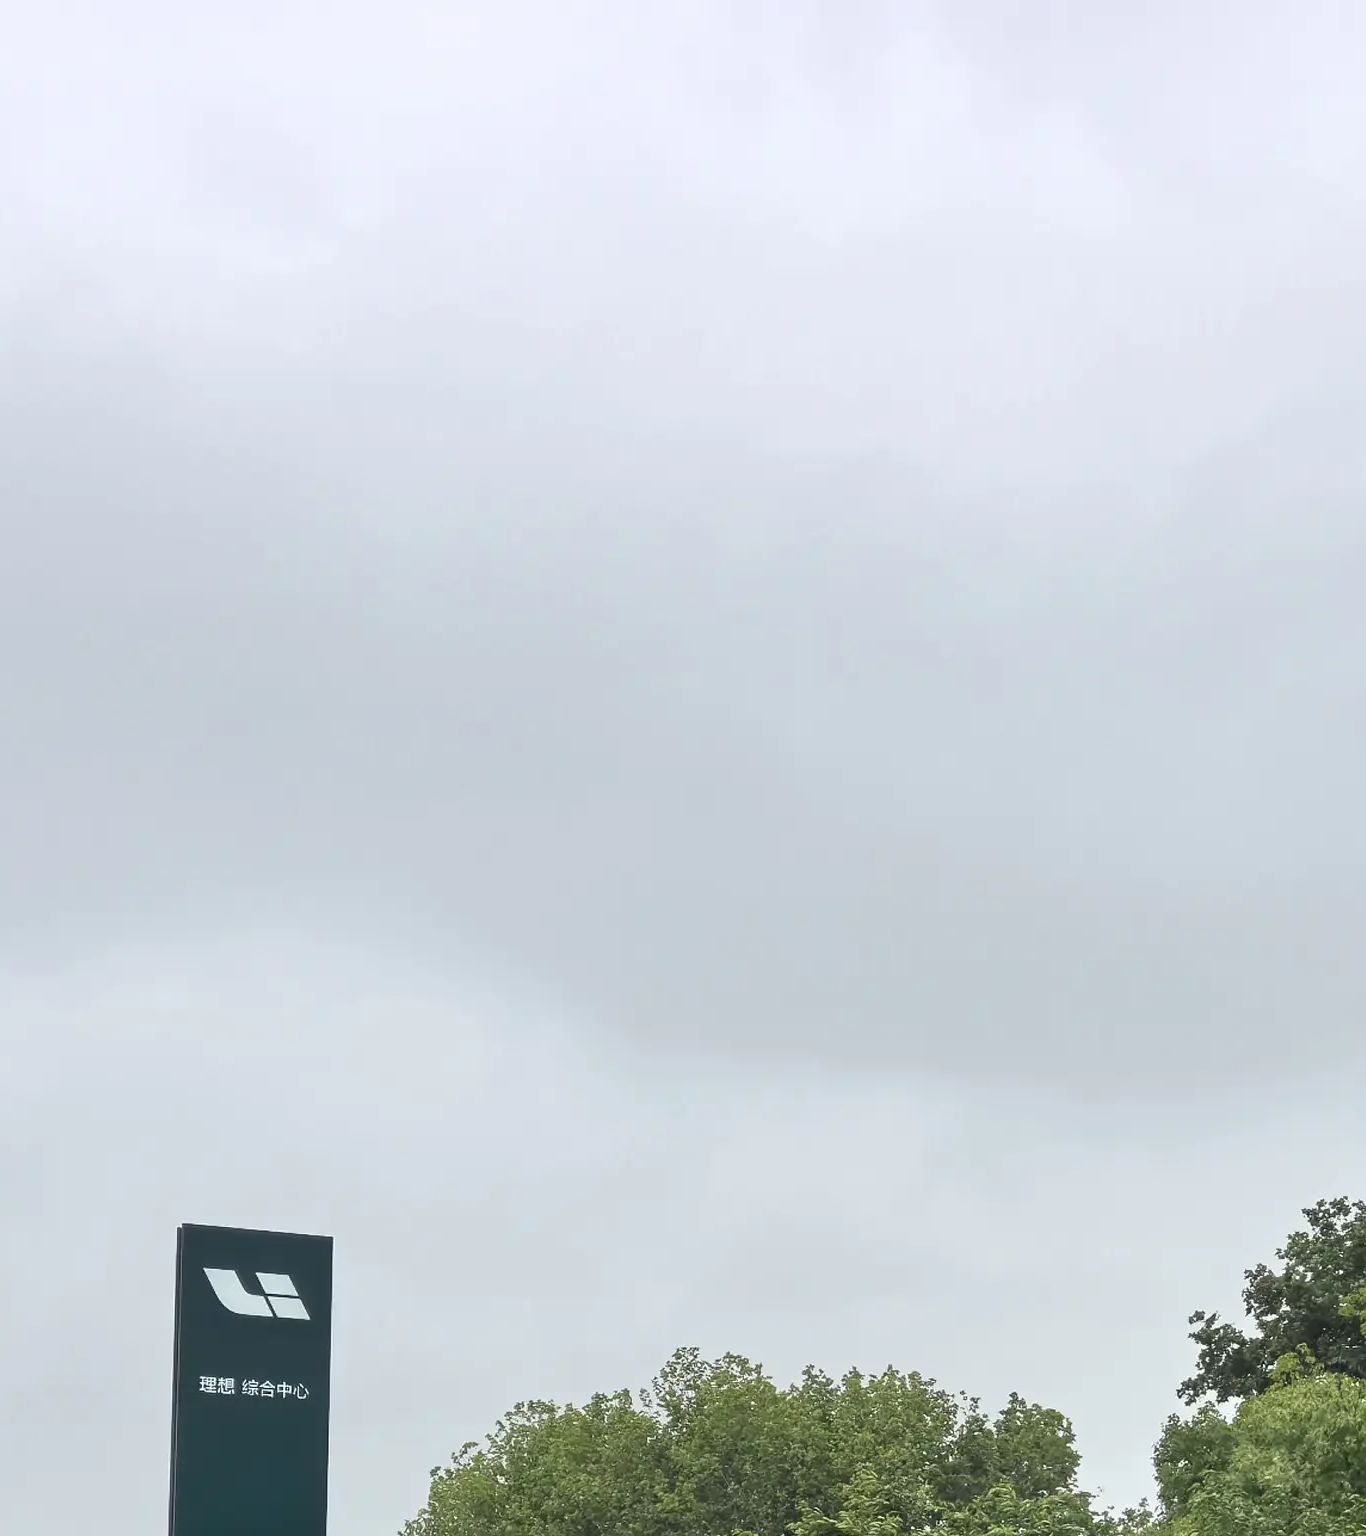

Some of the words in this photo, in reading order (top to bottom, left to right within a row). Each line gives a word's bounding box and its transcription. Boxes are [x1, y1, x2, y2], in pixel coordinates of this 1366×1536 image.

[199, 1376, 235, 1396] 理想
[242, 1379, 310, 1400] 综合中心
